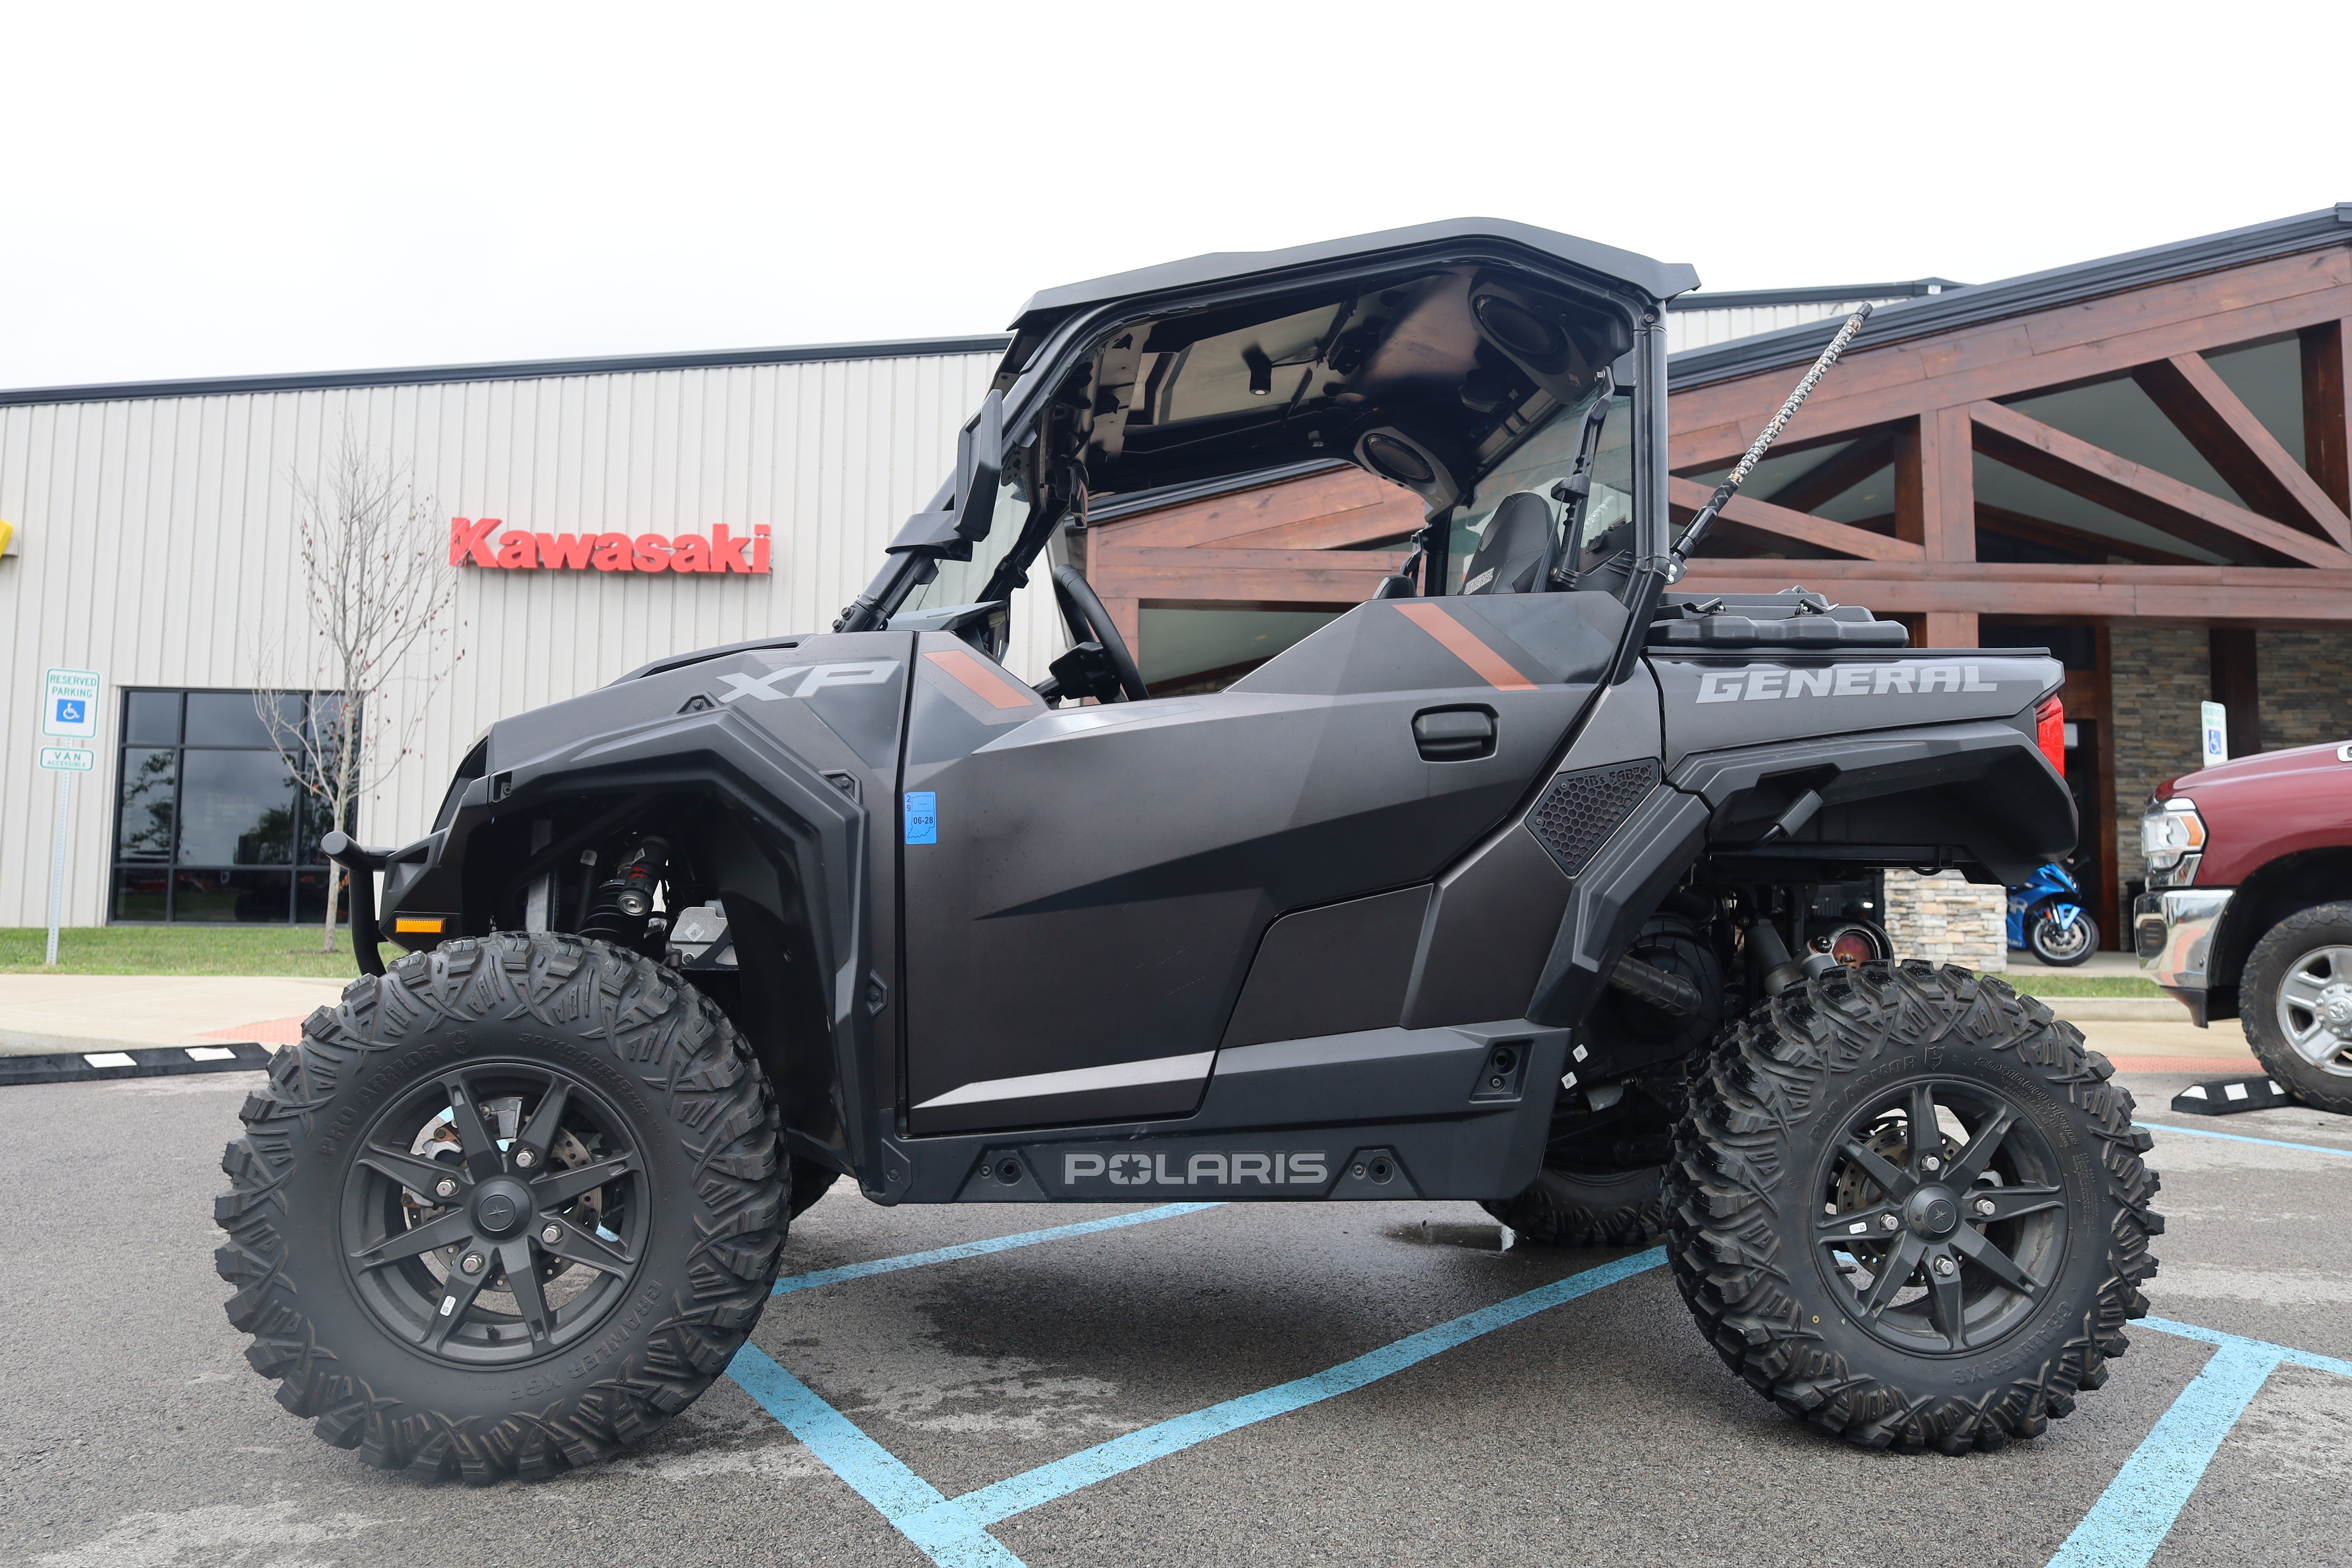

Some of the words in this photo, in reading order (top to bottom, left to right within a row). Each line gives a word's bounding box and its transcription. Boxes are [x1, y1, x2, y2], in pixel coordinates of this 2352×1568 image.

[449, 517, 772, 574] Kawasaki
[1464, 568, 1495, 595] GENERAL
[50, 674, 97, 687] RESERVED
[52, 686, 93, 698] PARKING
[716, 660, 901, 703] XP
[1695, 666, 1998, 704] GENERAL
[55, 752, 81, 761] VAN
[317, 1107, 357, 1157] PRO
[355, 1043, 442, 1107] ARMOR
[1808, 1099, 1842, 1142] PRO
[1844, 1055, 1917, 1102] ARMOR
[1064, 1153, 1328, 1185] POLARIS
